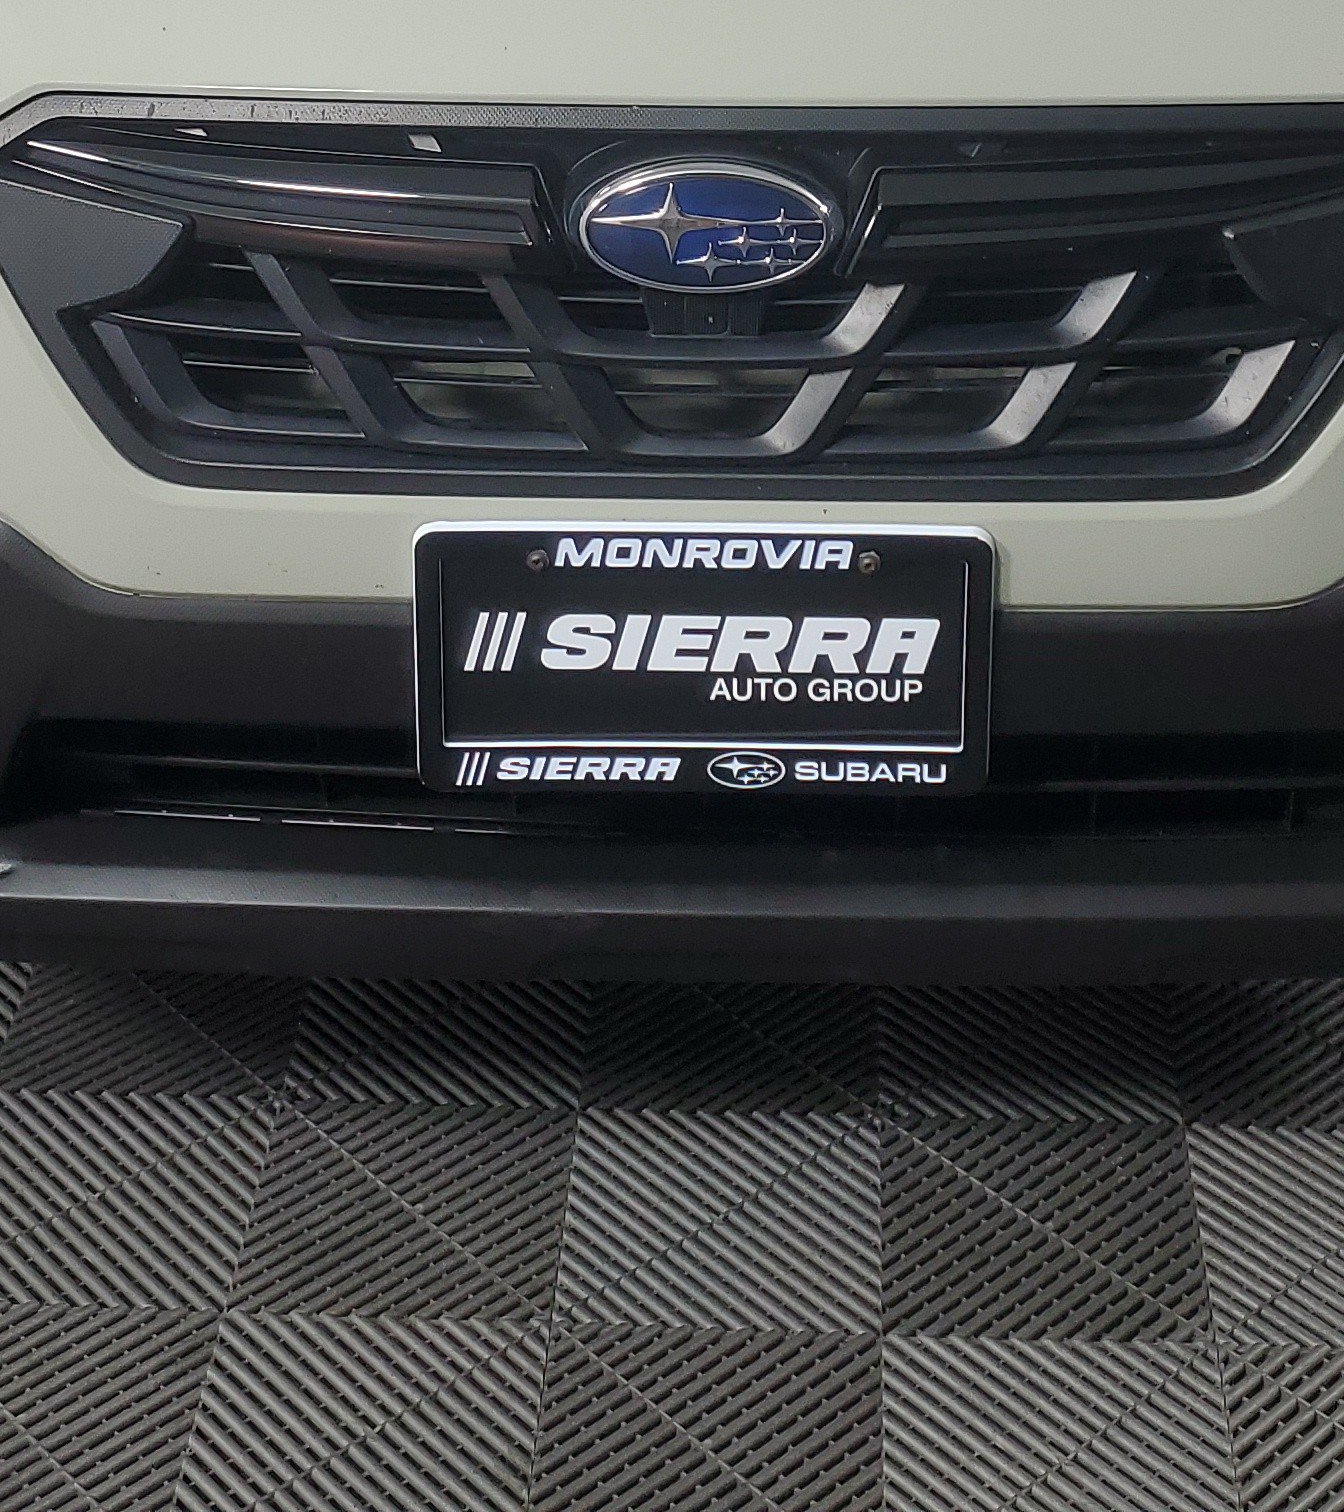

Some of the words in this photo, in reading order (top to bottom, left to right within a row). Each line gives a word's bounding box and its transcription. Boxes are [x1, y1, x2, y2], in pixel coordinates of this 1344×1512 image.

[554, 537, 854, 570] MONROVIA
[540, 613, 941, 675] SIERRA
[709, 677, 798, 702] AUTO
[807, 677, 923, 703] GROUP
[496, 756, 682, 781] SIERRA
[794, 760, 947, 784] SUBARU
